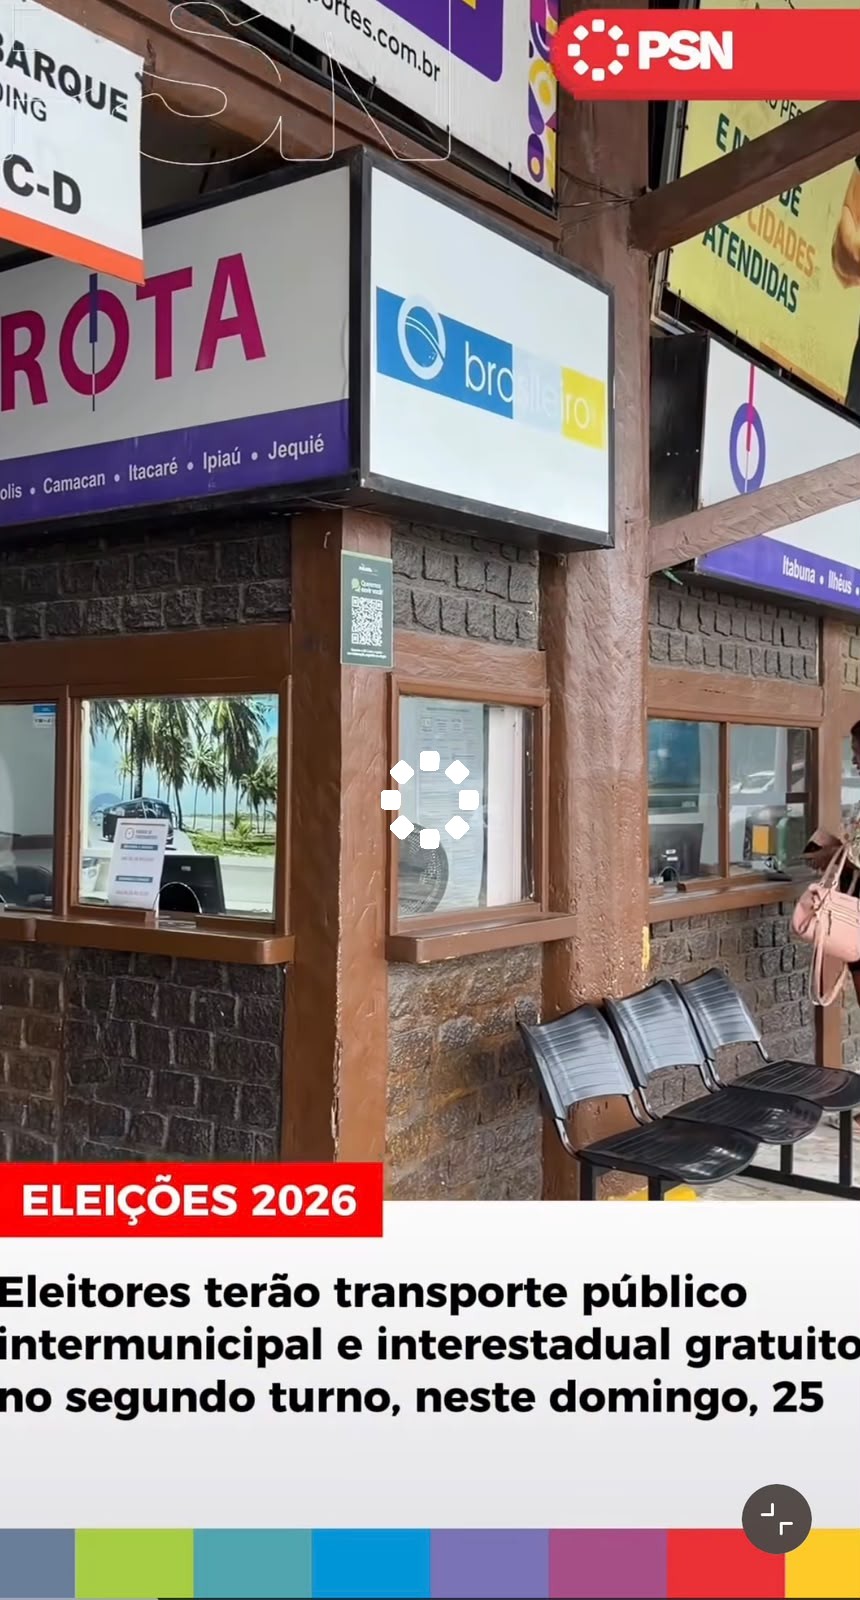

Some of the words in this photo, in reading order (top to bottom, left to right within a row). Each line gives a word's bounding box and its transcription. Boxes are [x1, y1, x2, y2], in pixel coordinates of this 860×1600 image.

[0, 32, 129, 123] ARQUE
[0, 83, 47, 122] ING
[3, 154, 82, 215] C-D
[702, 222, 799, 313] ATENDIDAS
[747, 204, 816, 278] CIDADES
[0, 252, 267, 412] ROTA
[43, 472, 106, 494] Camacan
[129, 457, 178, 482] Itacaré
[203, 446, 241, 473] Ipiaú
[268, 433, 324, 461] Jequié
[782, 554, 816, 585] Itabuna
[827, 569, 852, 595] Ilhéus
